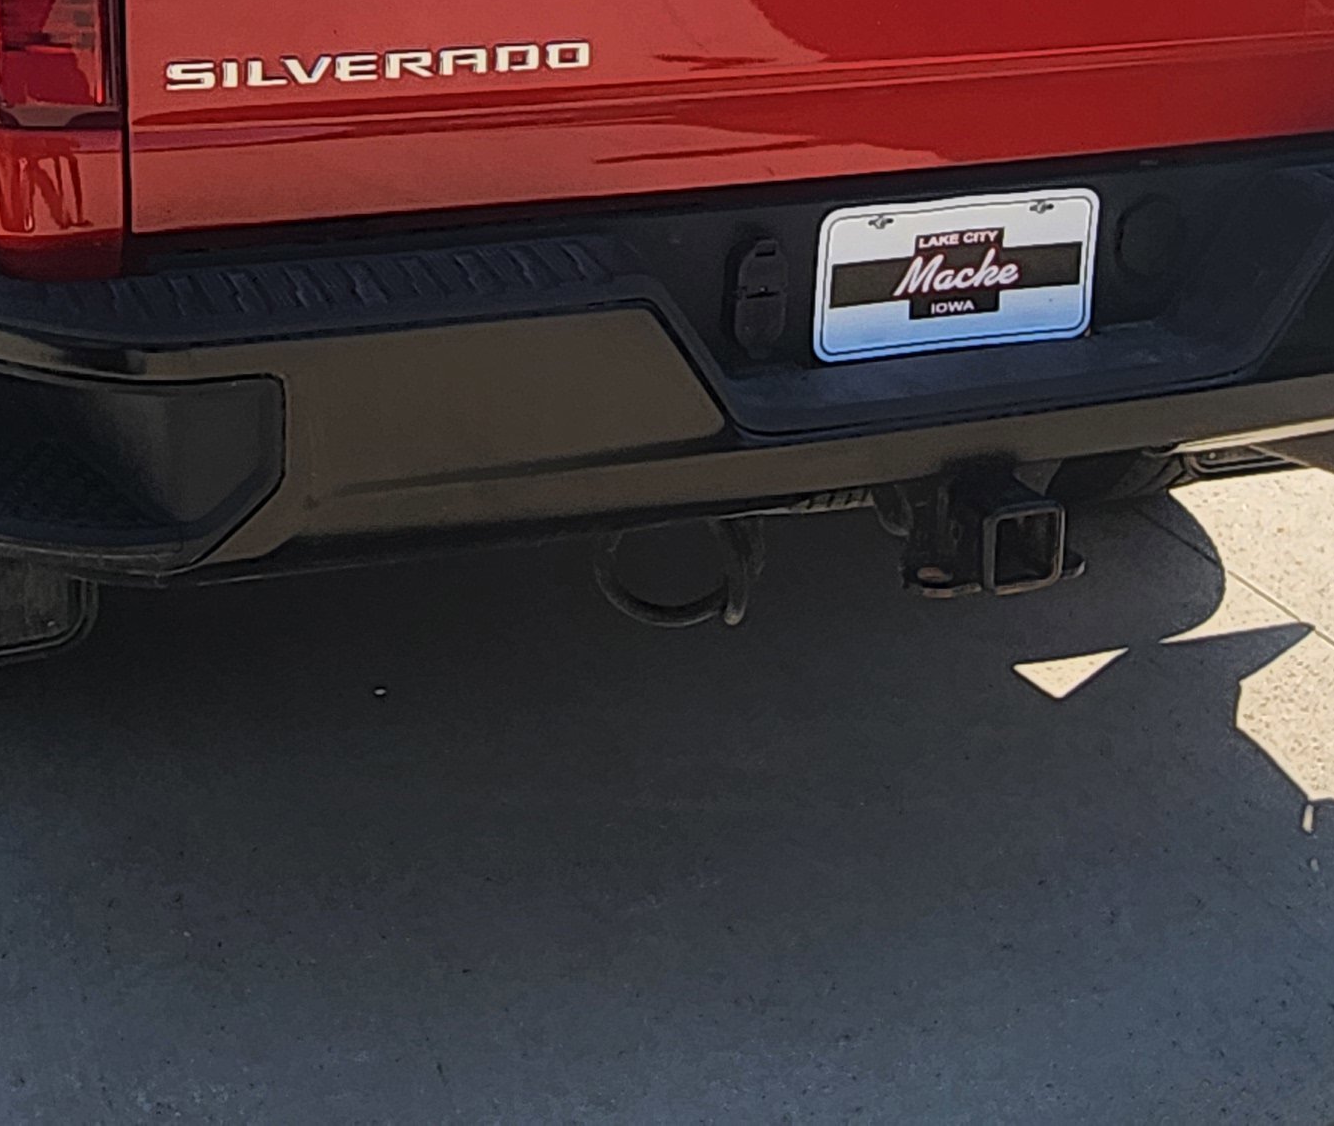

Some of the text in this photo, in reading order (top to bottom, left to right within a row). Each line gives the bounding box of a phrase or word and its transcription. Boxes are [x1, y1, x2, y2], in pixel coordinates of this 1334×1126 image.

[165, 41, 591, 91] SILVERADO
[918, 229, 999, 249] LAKE CITY
[892, 247, 1020, 297] Macke
[930, 300, 975, 314] IOWA
